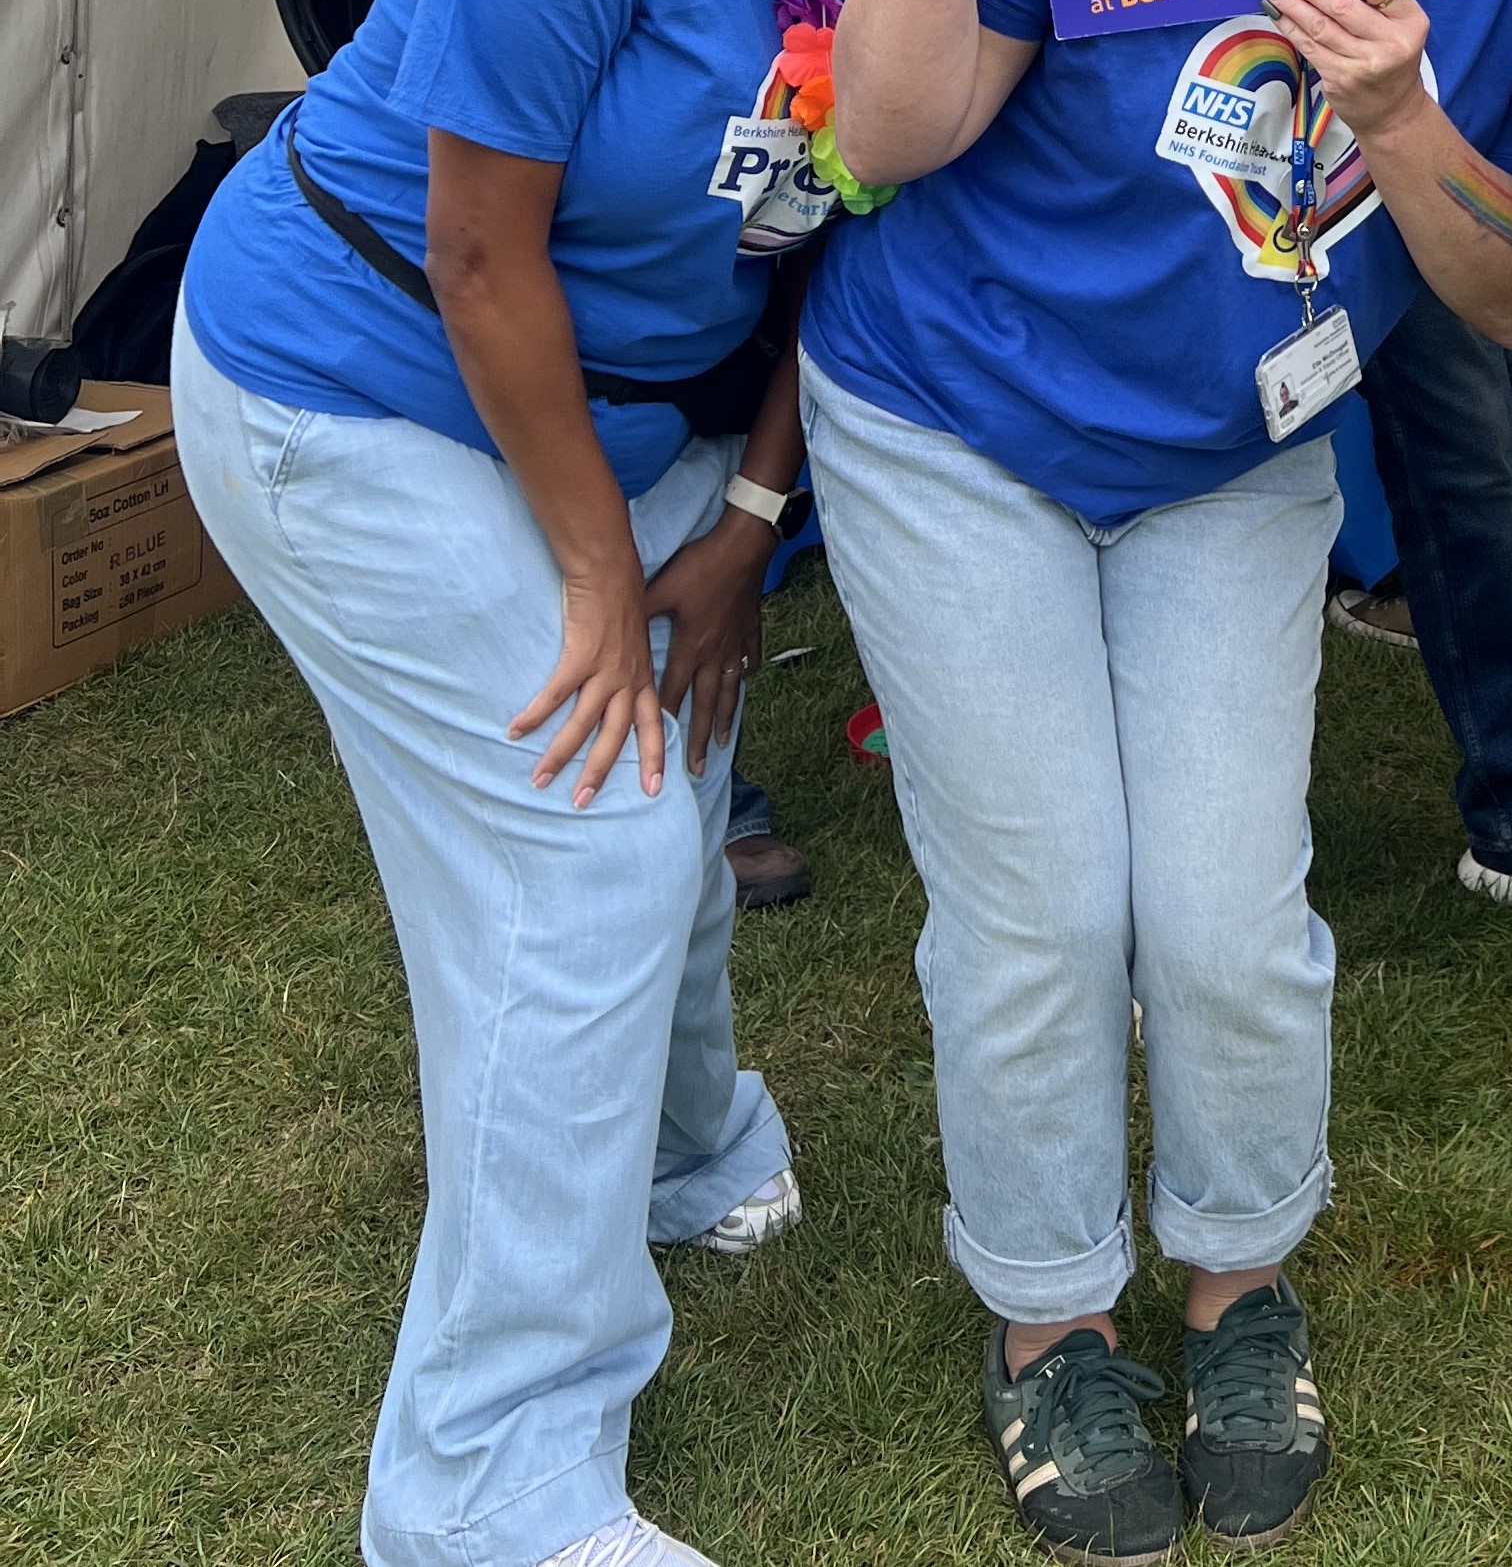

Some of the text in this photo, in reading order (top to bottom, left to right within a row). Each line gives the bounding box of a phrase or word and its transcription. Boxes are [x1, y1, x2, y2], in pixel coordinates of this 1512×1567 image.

[1184, 86, 1254, 126] NHS
[733, 125, 786, 138] Berkshire
[1168, 140, 1197, 157] NHS
[89, 506, 111, 523] 5oz
[113, 489, 151, 514] Cotton
[62, 546, 89, 565] Order
[91, 540, 104, 553] No
[62, 569, 89, 588] Color
[62, 595, 81, 612] Bag
[61, 610, 100, 634] Packing
